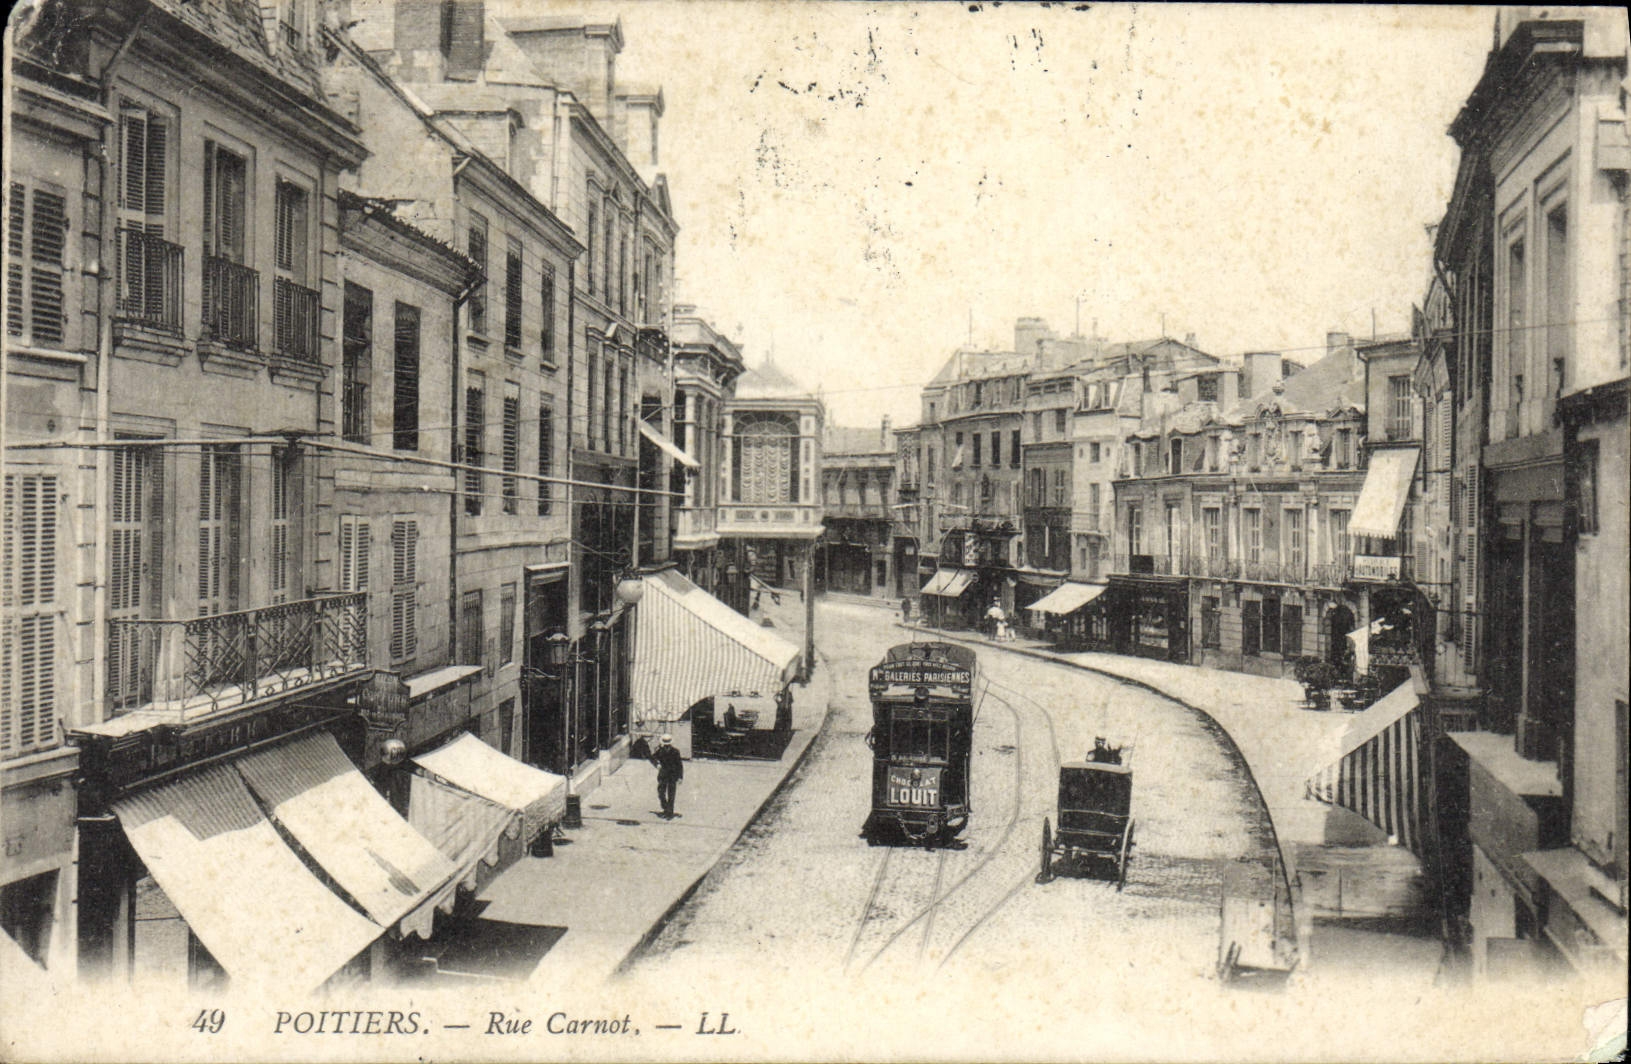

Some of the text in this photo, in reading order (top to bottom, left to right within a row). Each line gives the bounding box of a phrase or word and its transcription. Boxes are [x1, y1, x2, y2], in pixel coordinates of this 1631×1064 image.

[885, 671, 921, 682] GALERIES
[923, 672, 970, 684] PARISIENNES
[890, 775, 936, 787] CHOCLAT
[890, 787, 937, 806] LOUIT
